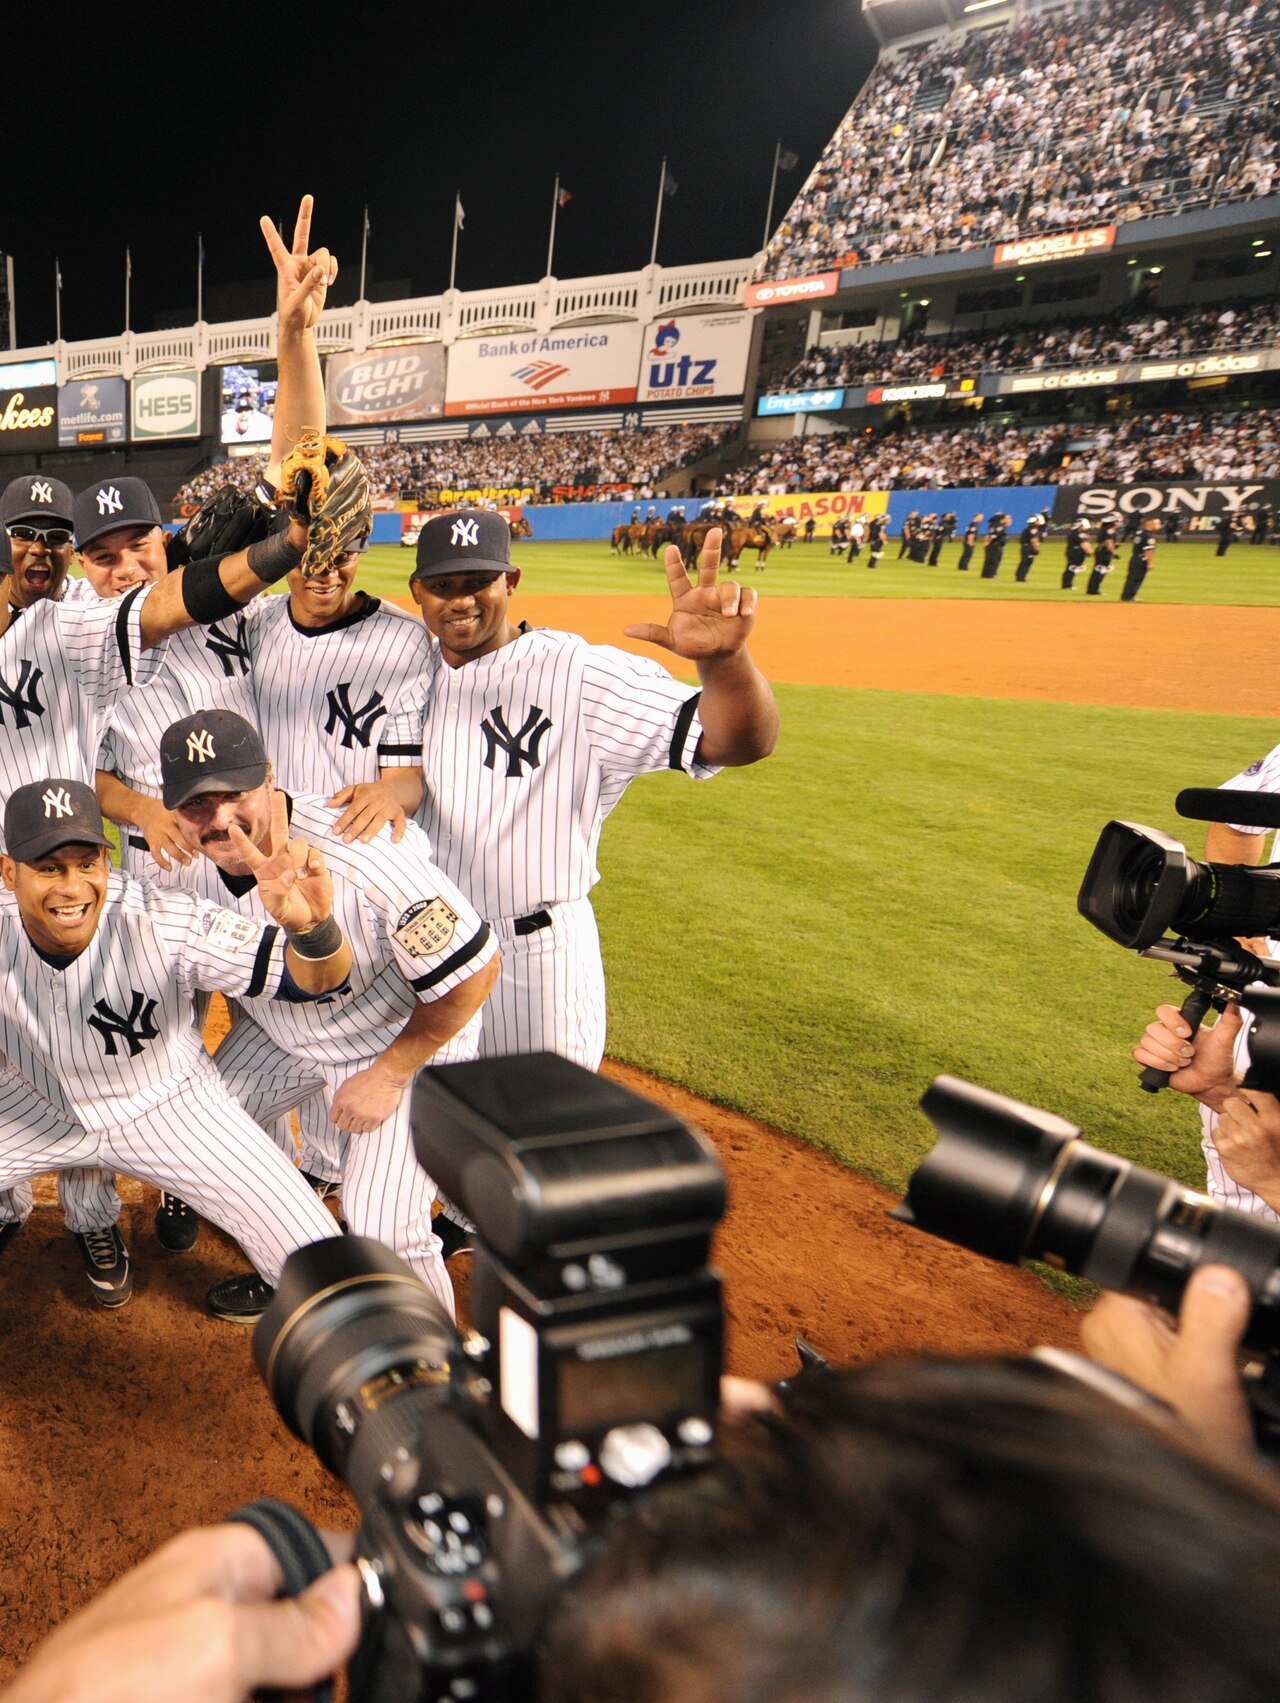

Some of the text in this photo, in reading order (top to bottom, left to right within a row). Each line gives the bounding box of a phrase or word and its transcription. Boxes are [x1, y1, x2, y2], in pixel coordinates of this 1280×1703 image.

[1001, 229, 1107, 262] MODELL'S
[775, 280, 825, 297] TOYOTA
[478, 333, 609, 358] Bank of America
[350, 355, 420, 385] BUD
[649, 355, 717, 388] utz
[1044, 369, 1118, 388] adidas
[1177, 355, 1260, 376] adidas
[341, 369, 430, 403] LIGHT
[647, 385, 715, 399] POTATO CHIPS
[139, 394, 192, 418] HESS
[465, 402, 491, 411] Official
[491, 400, 509, 409] Bank
[532, 396, 547, 406] New
[548, 396, 565, 404] York
[60, 412, 123, 425] metlife.com
[30, 481, 54, 504] NY
[96, 486, 125, 515] NY
[1077, 485, 1265, 515] SONY
[451, 519, 479, 546] NY
[324, 683, 389, 749] NY
[186, 729, 216, 763] NY
[480, 705, 553, 777] NY
[42, 787, 74, 819] NY
[88, 990, 160, 1057] NY
